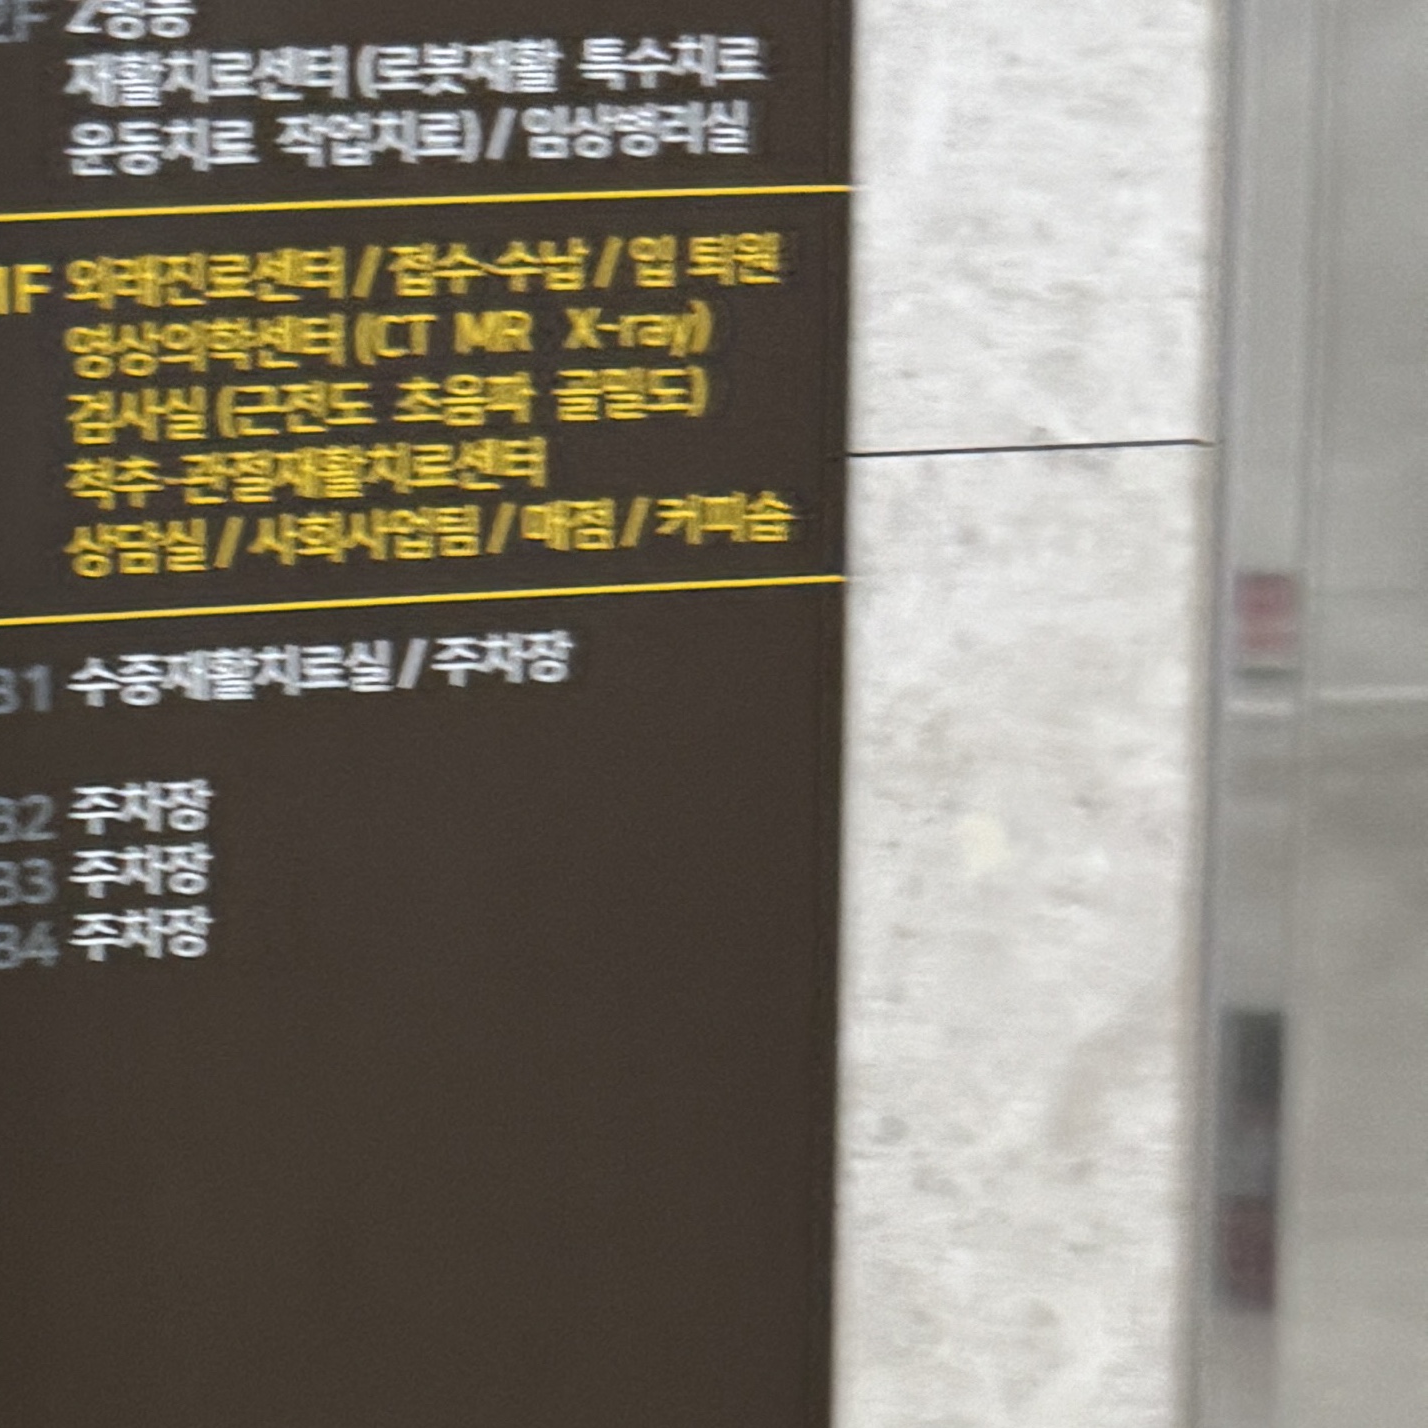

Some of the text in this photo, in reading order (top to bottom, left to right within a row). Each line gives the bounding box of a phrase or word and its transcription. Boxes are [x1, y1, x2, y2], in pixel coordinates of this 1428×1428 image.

[430, 630, 575, 687] 주차장
[68, 779, 214, 835] 주차장
[68, 842, 214, 898] 주차장
[68, 905, 214, 961] 주차장
